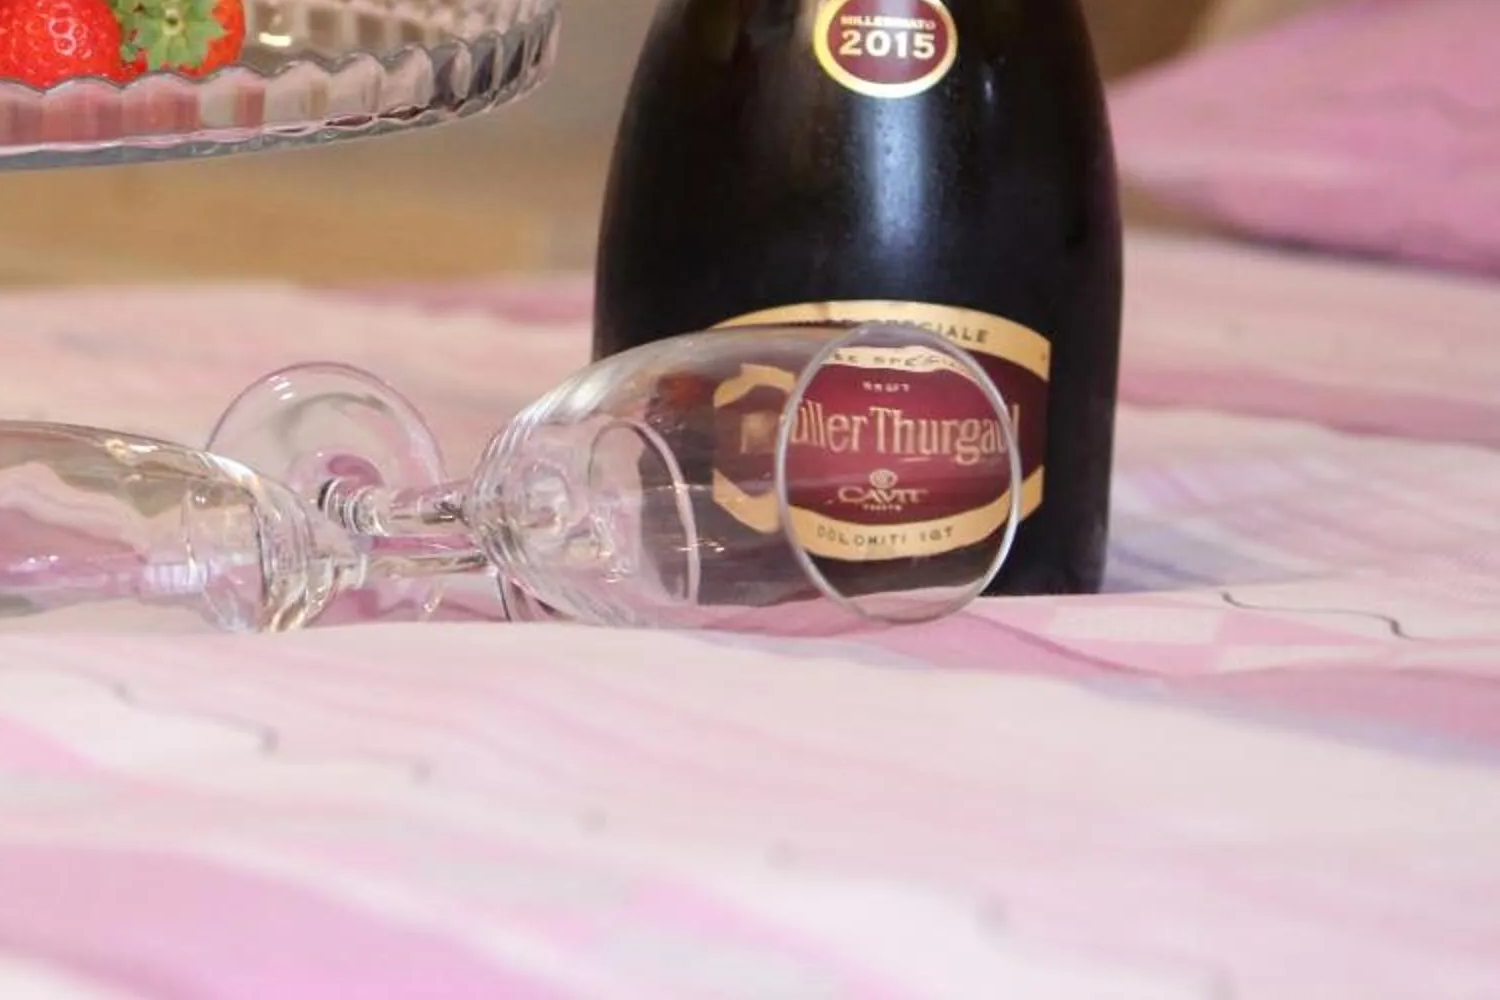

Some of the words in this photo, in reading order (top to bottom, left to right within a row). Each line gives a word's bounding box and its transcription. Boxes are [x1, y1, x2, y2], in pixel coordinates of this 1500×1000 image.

[839, 30, 935, 60] 2015
[837, 486, 929, 504] CAVIT
[816, 525, 907, 547] DOLOMITI
